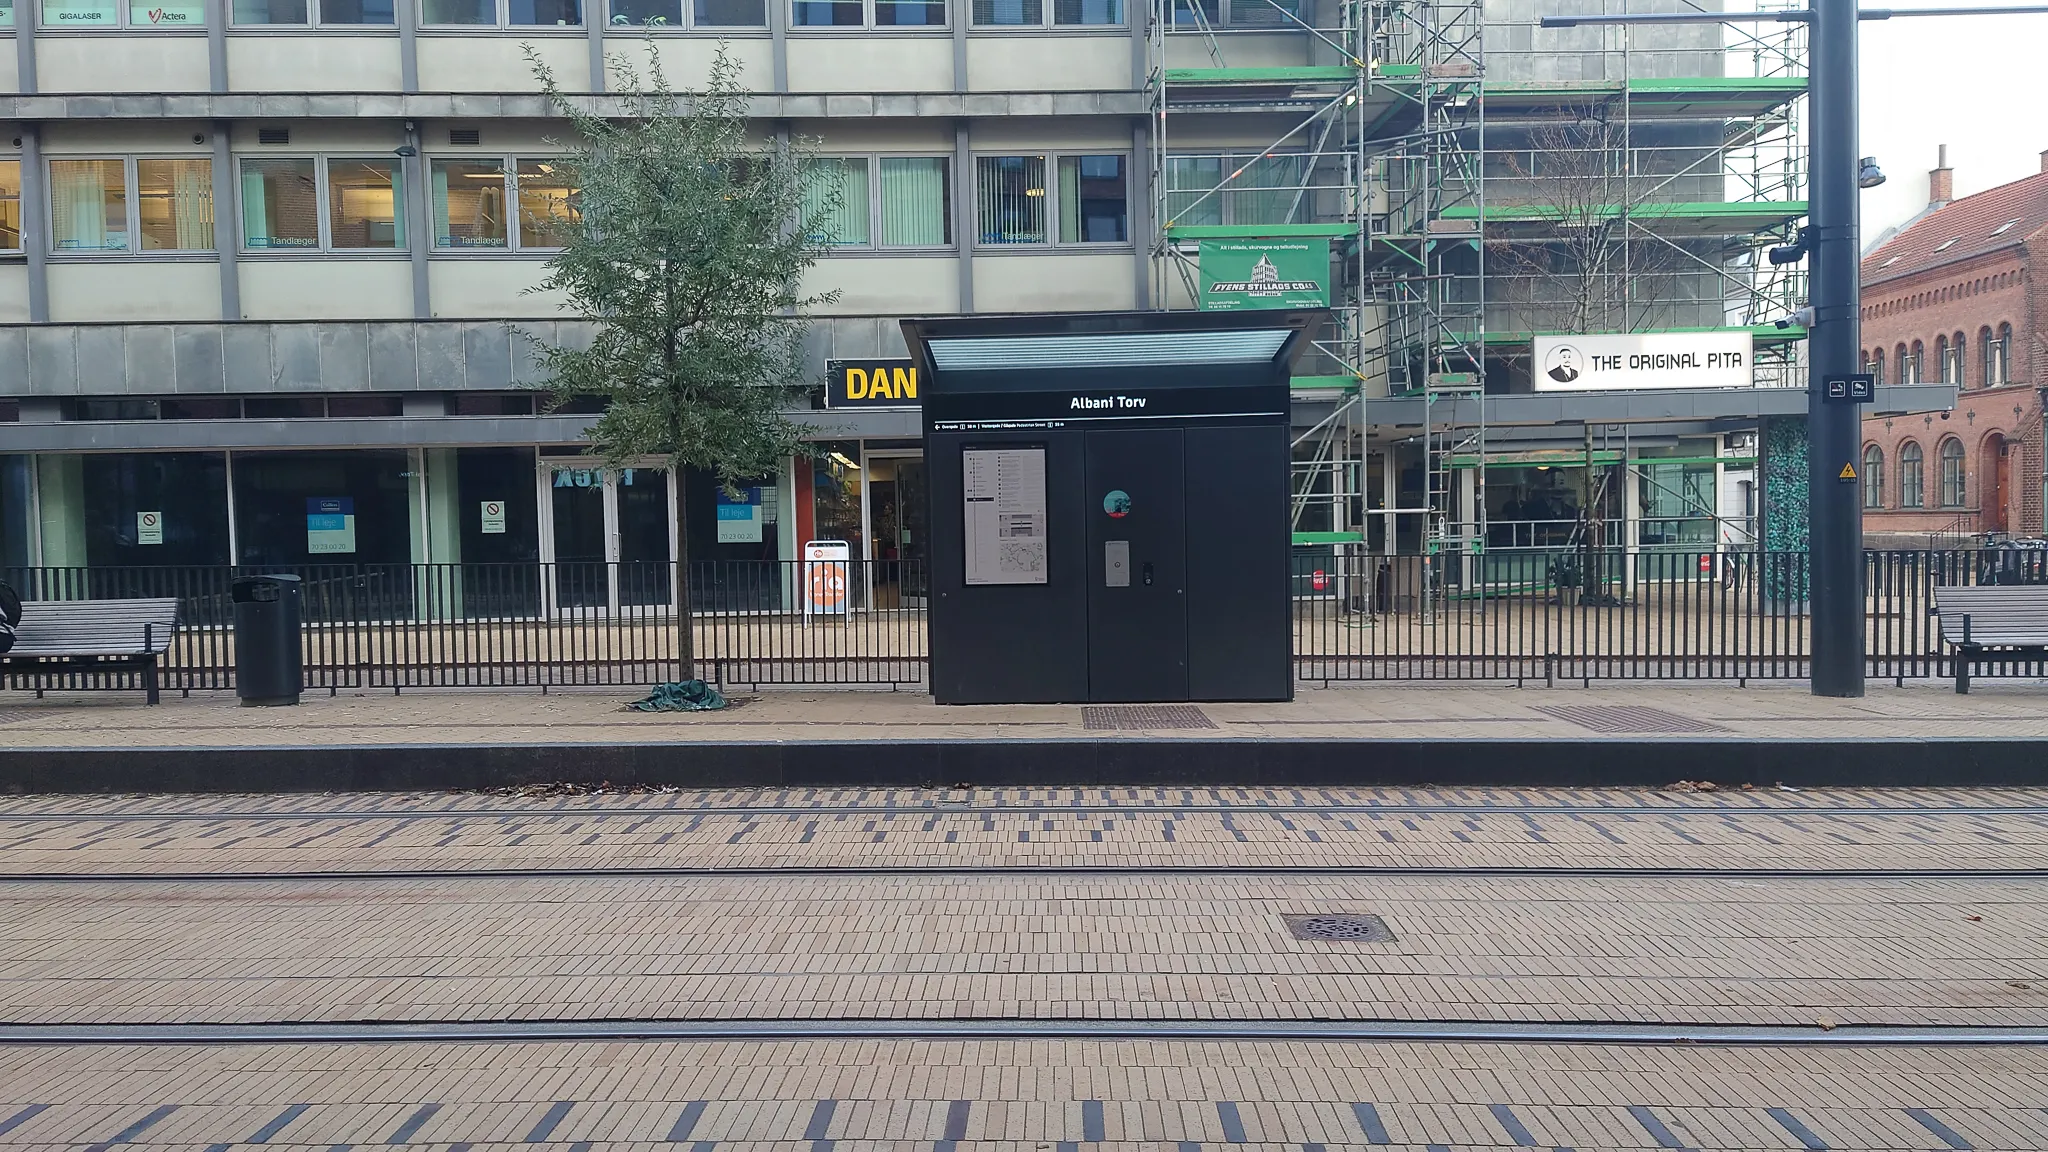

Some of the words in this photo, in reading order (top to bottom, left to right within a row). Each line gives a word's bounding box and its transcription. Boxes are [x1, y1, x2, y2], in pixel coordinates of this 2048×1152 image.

[161, 12, 186, 20] Actera
[271, 236, 316, 246] Tandlæger
[460, 236, 505, 246] Tandlæger
[1214, 284, 1246, 292] FYENS
[1247, 283, 1291, 291] STILLADS
[1591, 355, 1622, 371] THE
[1629, 352, 1701, 370] ORIGINAL
[1707, 352, 1742, 369] PITA
[846, 367, 917, 400] DAN
[1070, 396, 1114, 409] Albani
[1116, 396, 1147, 408] Torv
[809, 568, 844, 591] ria
